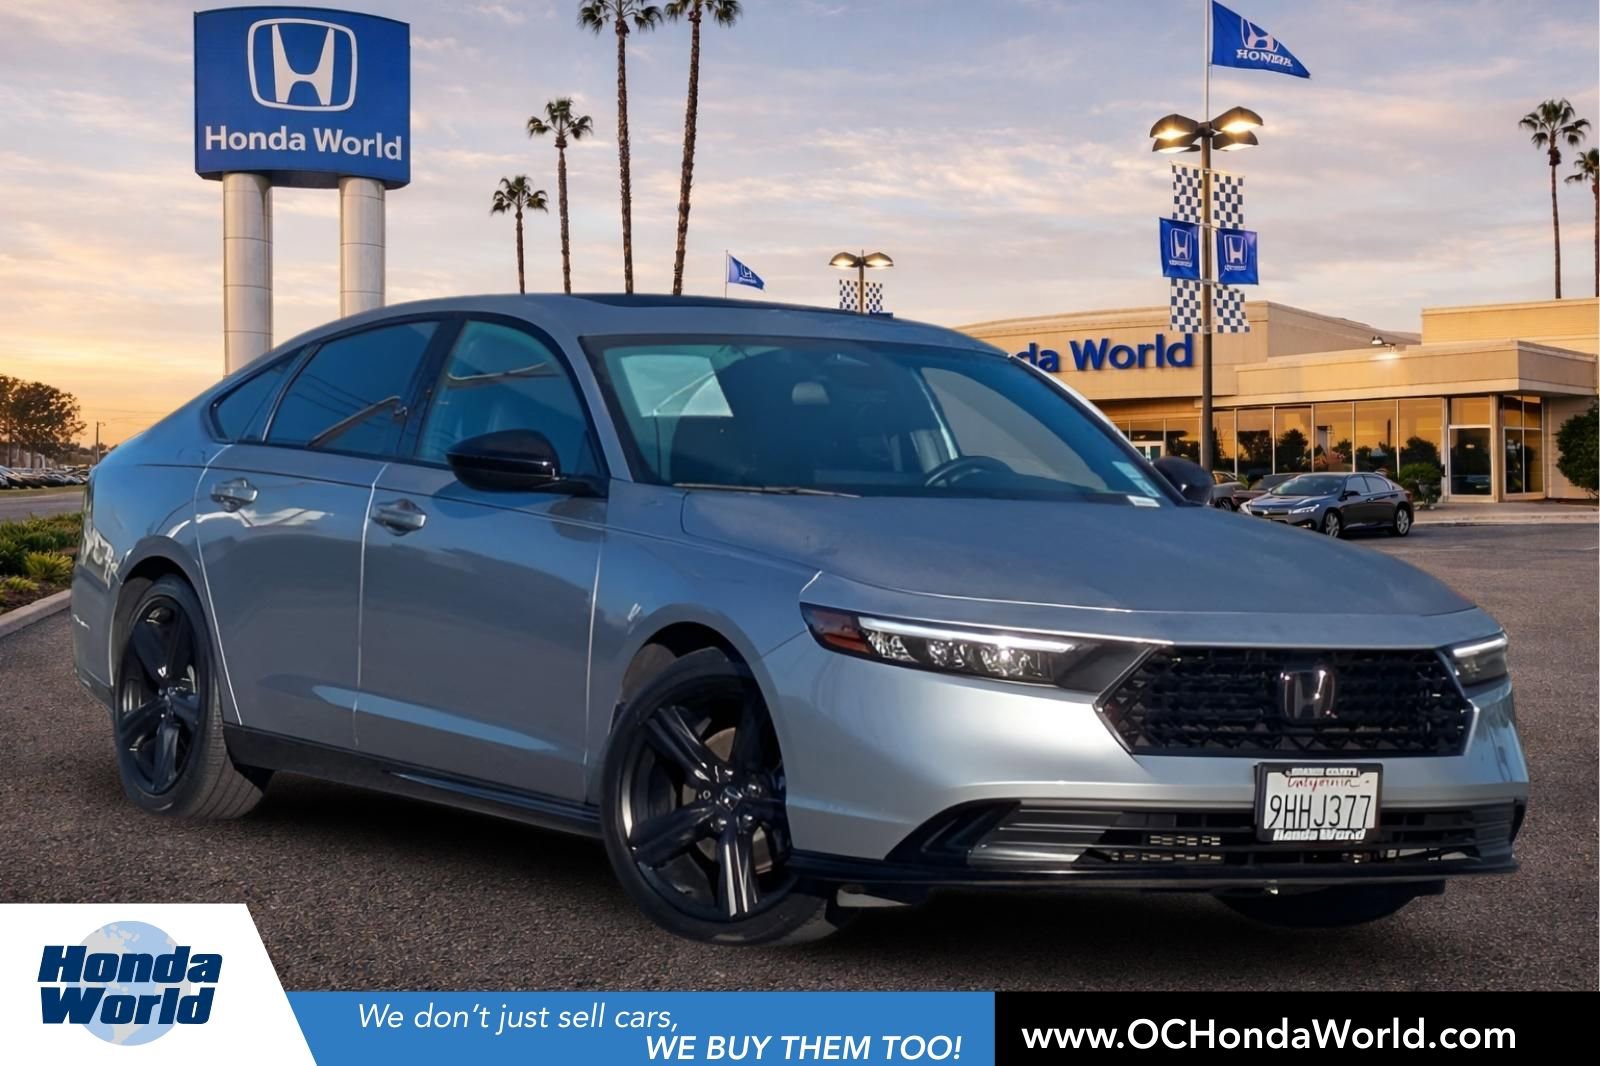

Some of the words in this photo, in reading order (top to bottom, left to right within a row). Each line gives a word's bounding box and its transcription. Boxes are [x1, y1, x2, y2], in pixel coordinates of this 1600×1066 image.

[205, 125, 306, 151] Honda
[313, 127, 402, 160] World
[1069, 333, 1195, 371] World
[1268, 794, 1371, 829] 9HHJ377
